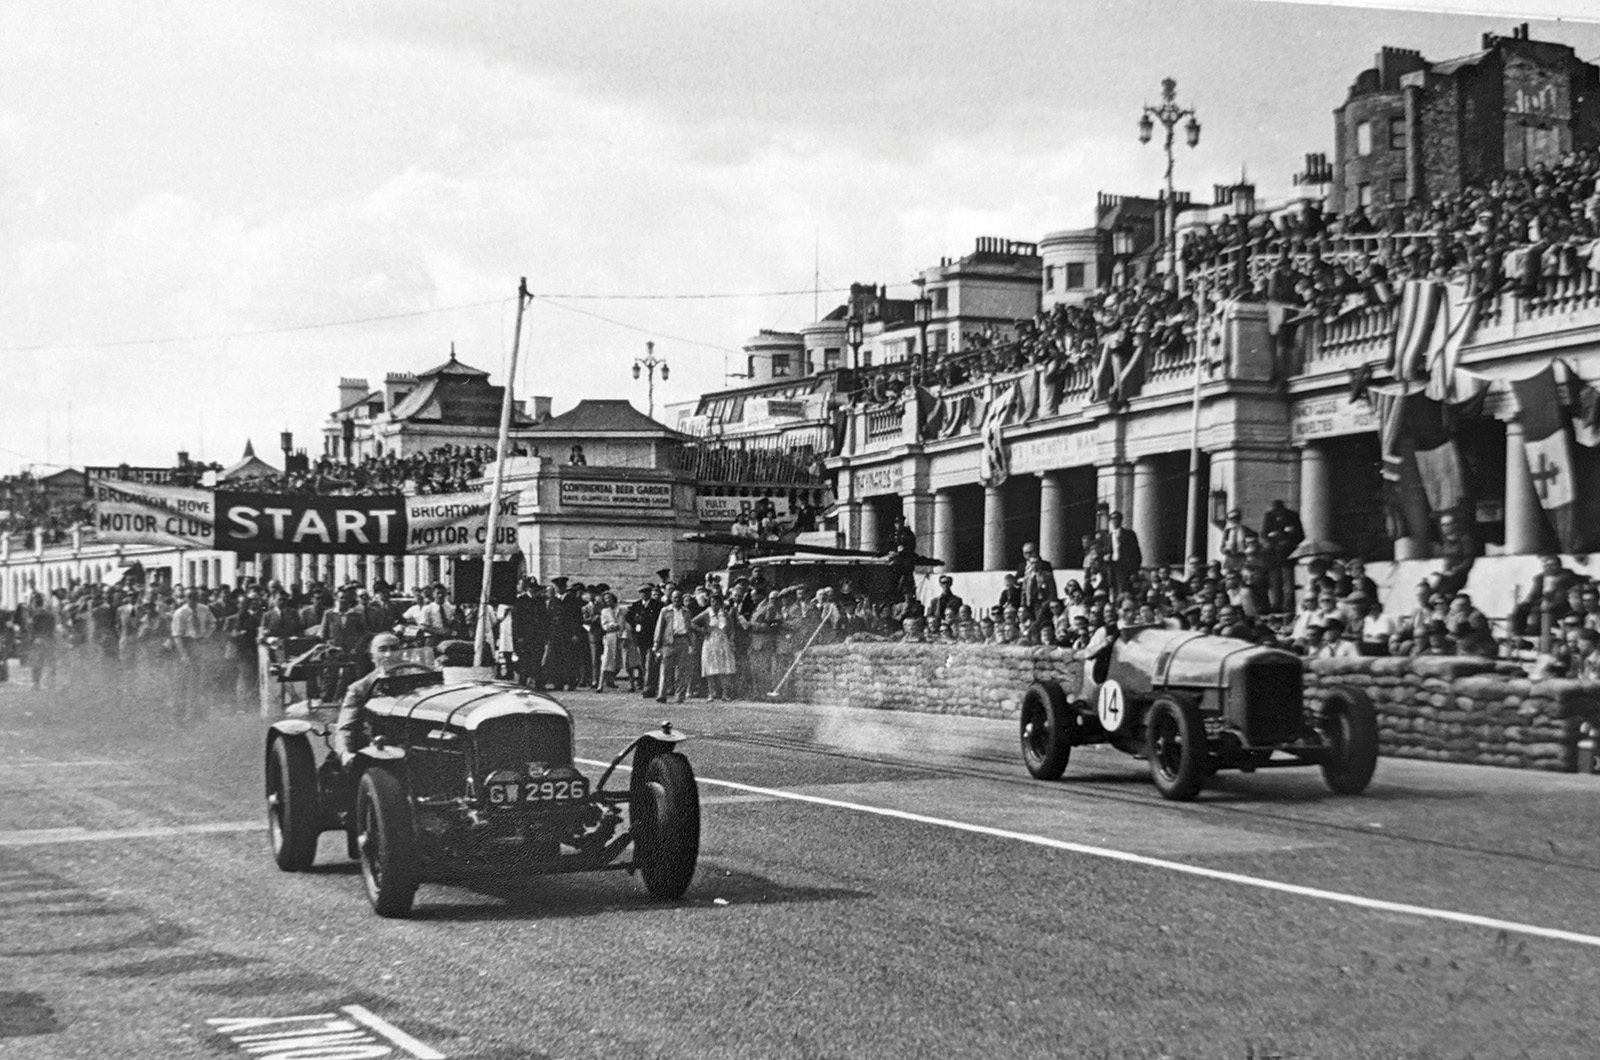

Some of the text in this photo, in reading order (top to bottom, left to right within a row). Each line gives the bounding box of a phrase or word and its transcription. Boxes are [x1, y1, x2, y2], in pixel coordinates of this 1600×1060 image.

[563, 483, 612, 494] CONTINENTAL
[615, 484, 634, 494] BEER
[177, 499, 211, 514] HOVE
[101, 513, 212, 537] MOTOR CLUB
[227, 505, 397, 543] START
[411, 526, 517, 544] MOTOR CUB
[1103, 687, 1119, 722] 14
[525, 780, 584, 801] 2926
